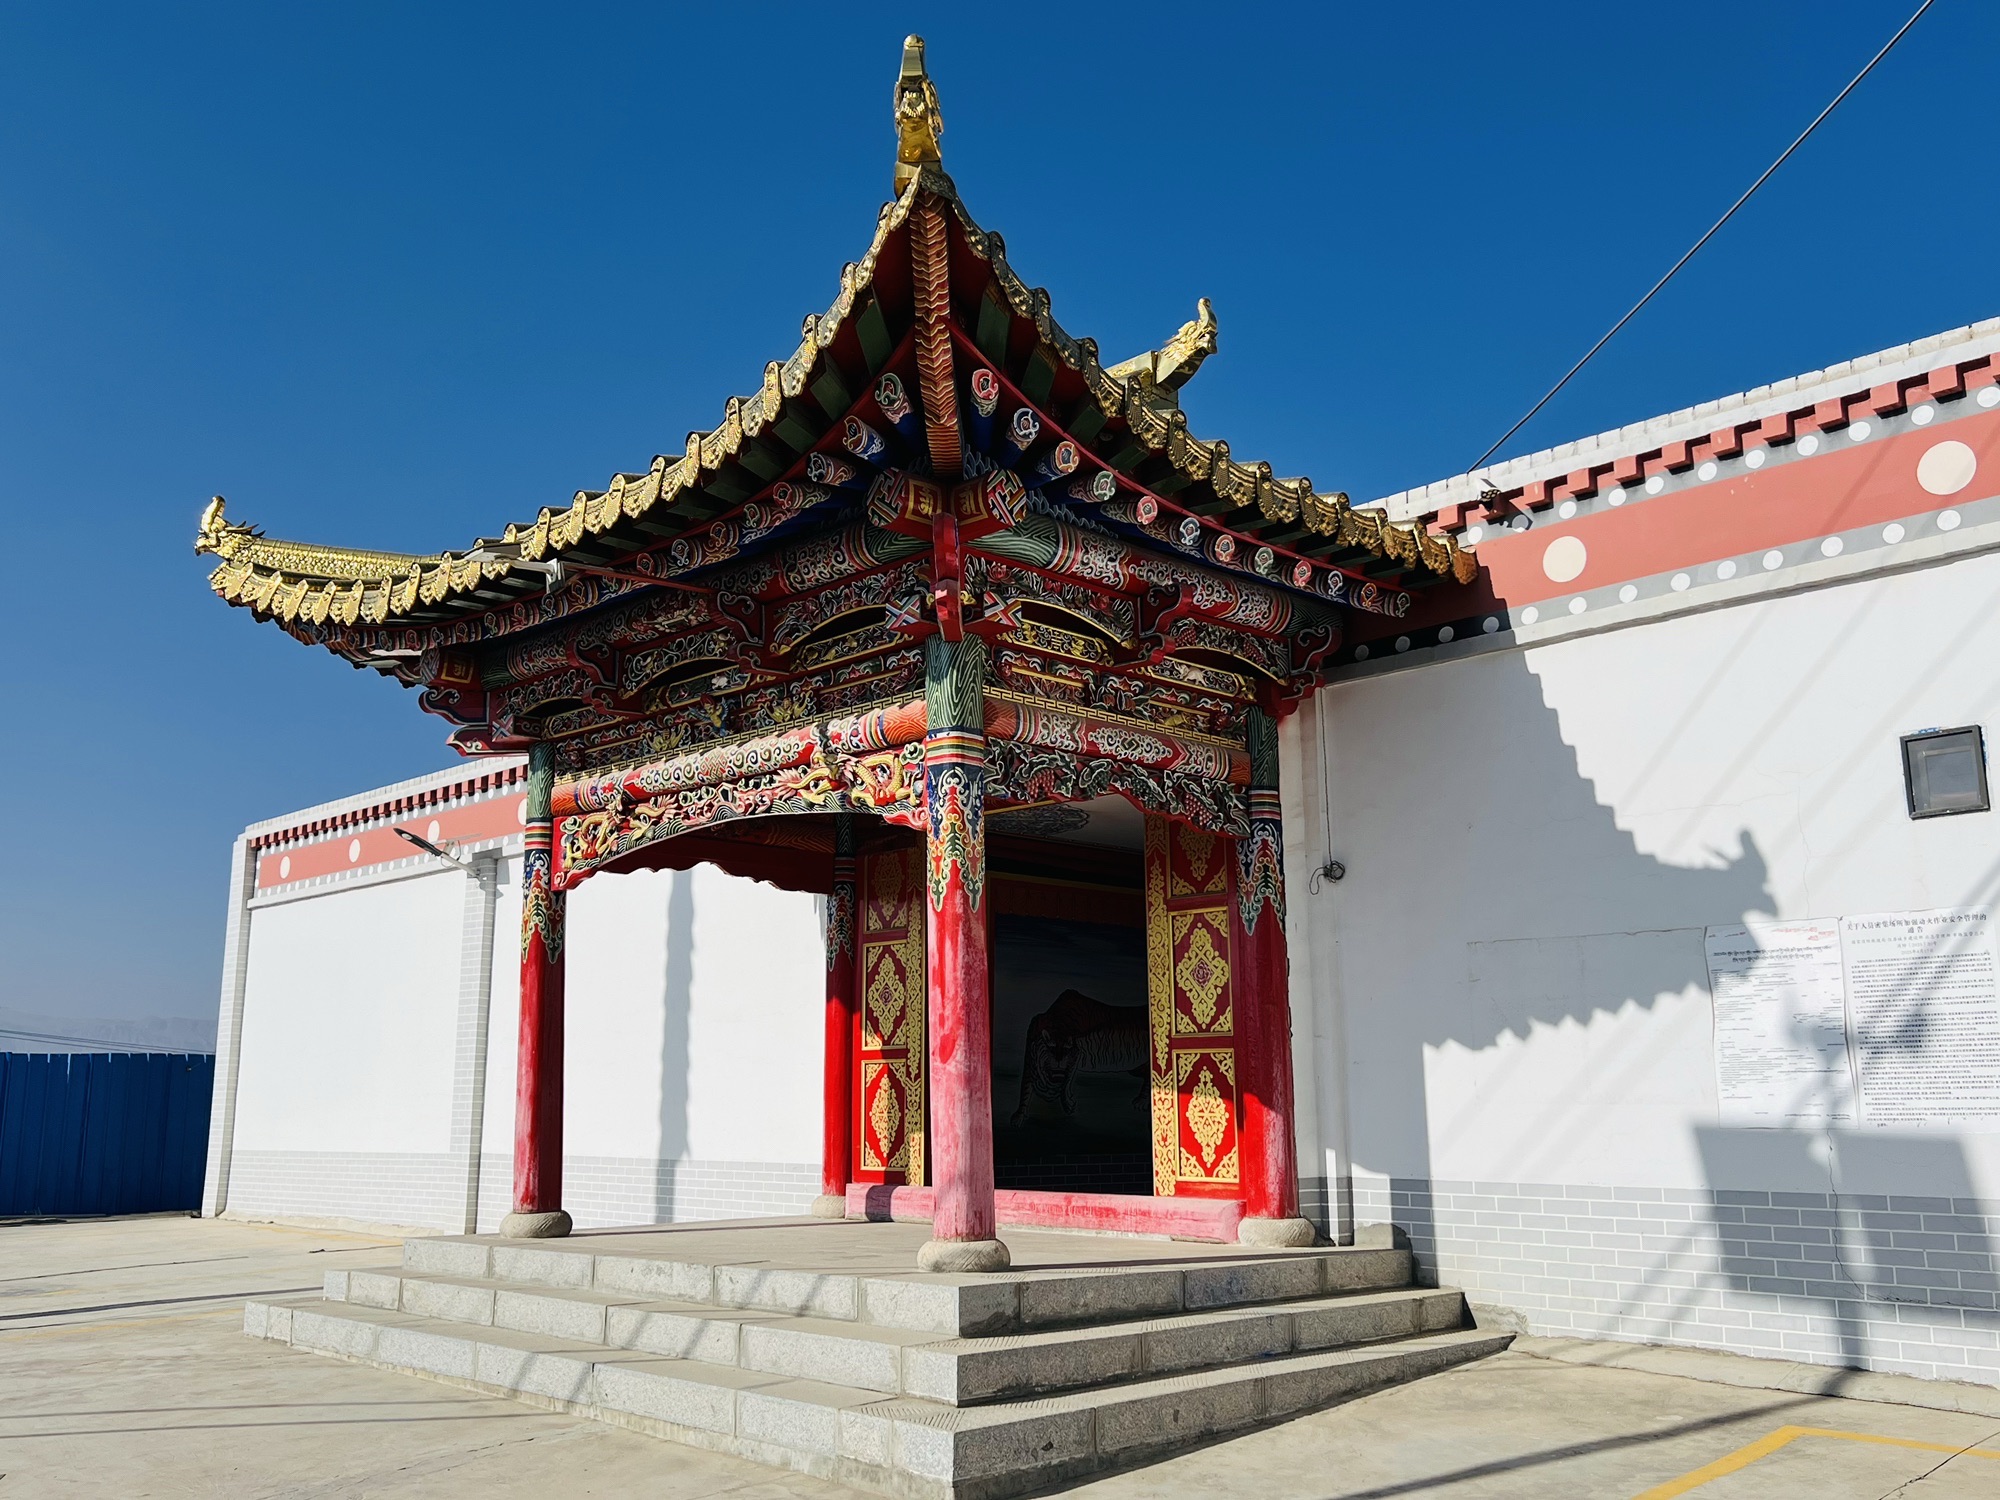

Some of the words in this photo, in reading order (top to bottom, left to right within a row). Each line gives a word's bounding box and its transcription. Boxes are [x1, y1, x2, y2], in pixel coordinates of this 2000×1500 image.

[1847, 914, 1987, 930] 关于人员密集场所加强动火作业安全管理的
